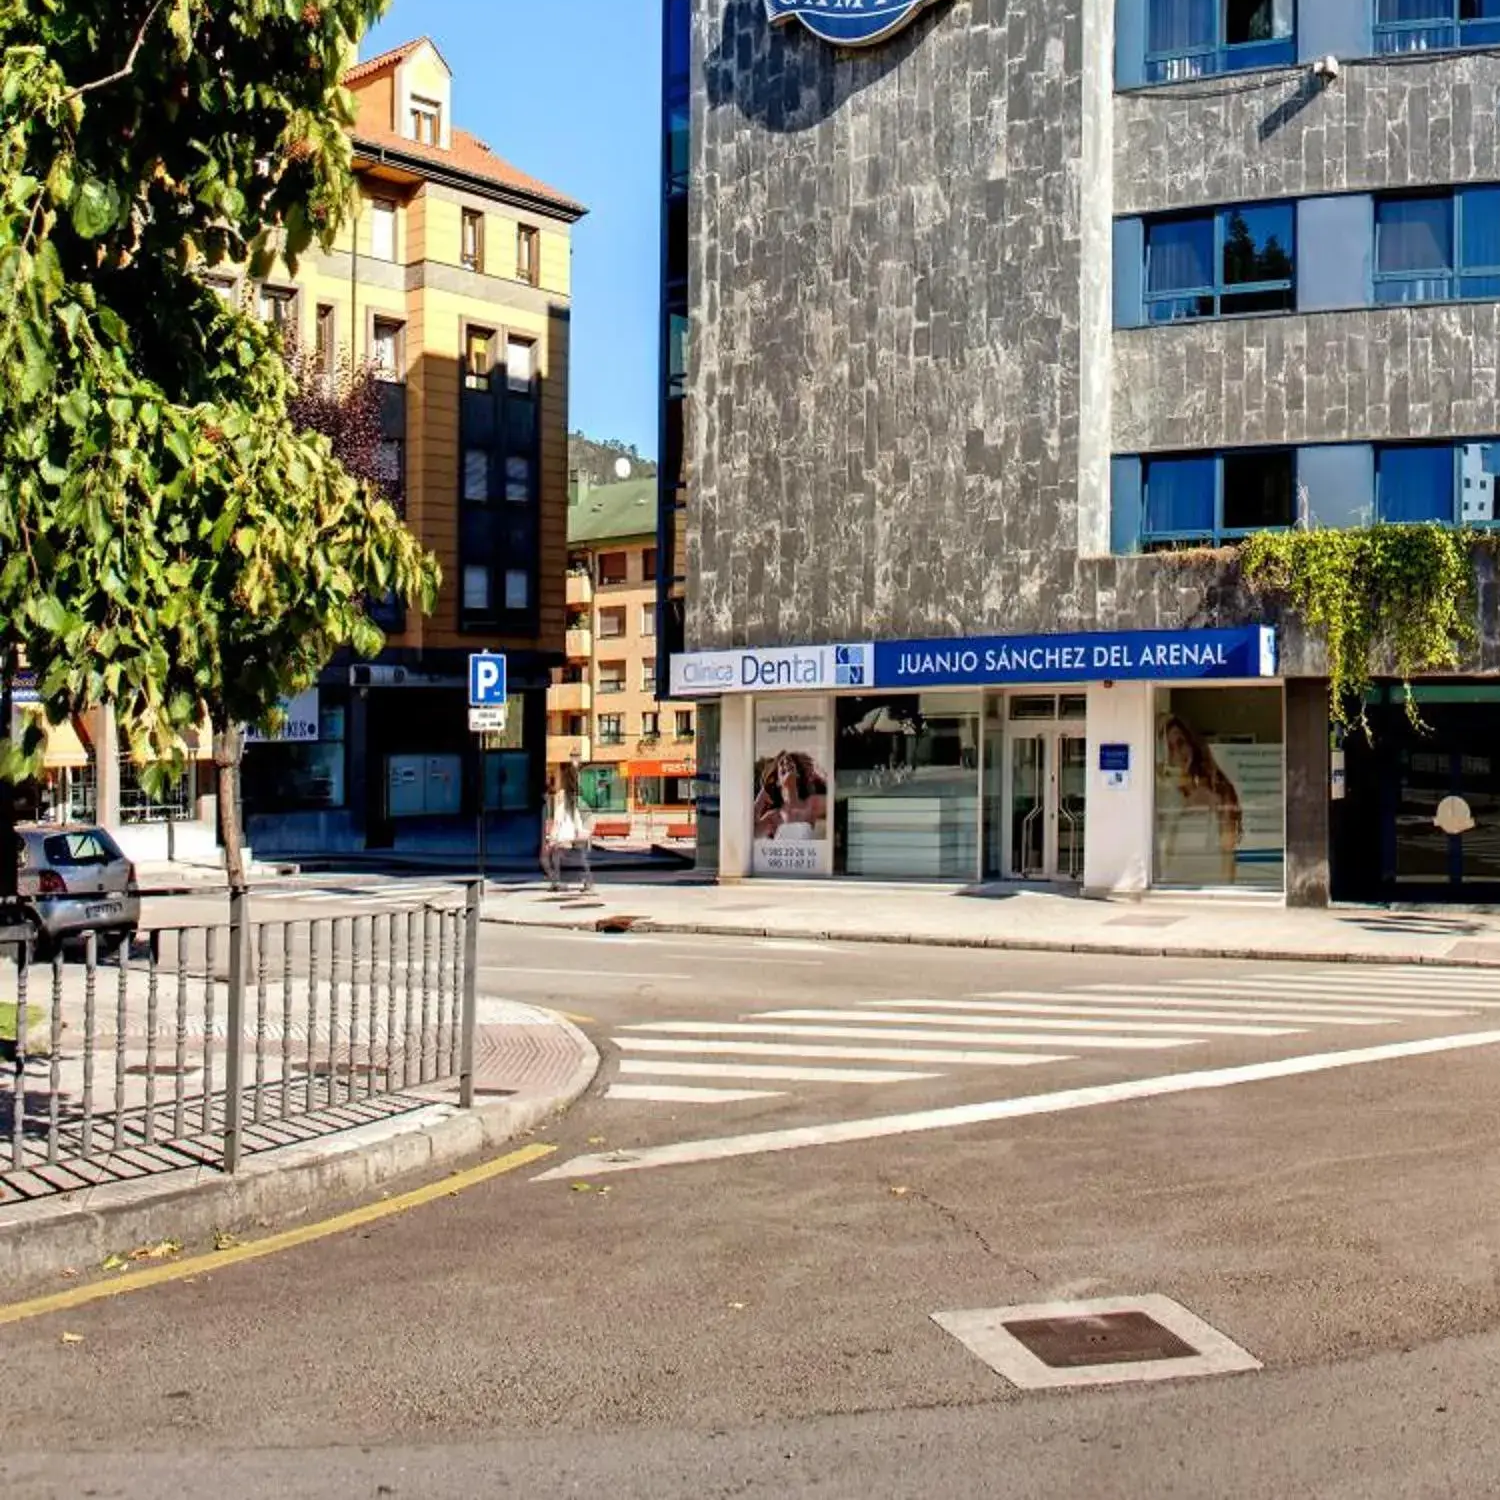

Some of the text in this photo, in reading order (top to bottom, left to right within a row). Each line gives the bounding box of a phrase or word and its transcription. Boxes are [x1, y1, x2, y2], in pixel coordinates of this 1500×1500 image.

[740, 649, 825, 685] Dental
[897, 643, 1228, 674] JUANJO SÁNCHEZ DEL ARENAL
[477, 660, 499, 700] P
